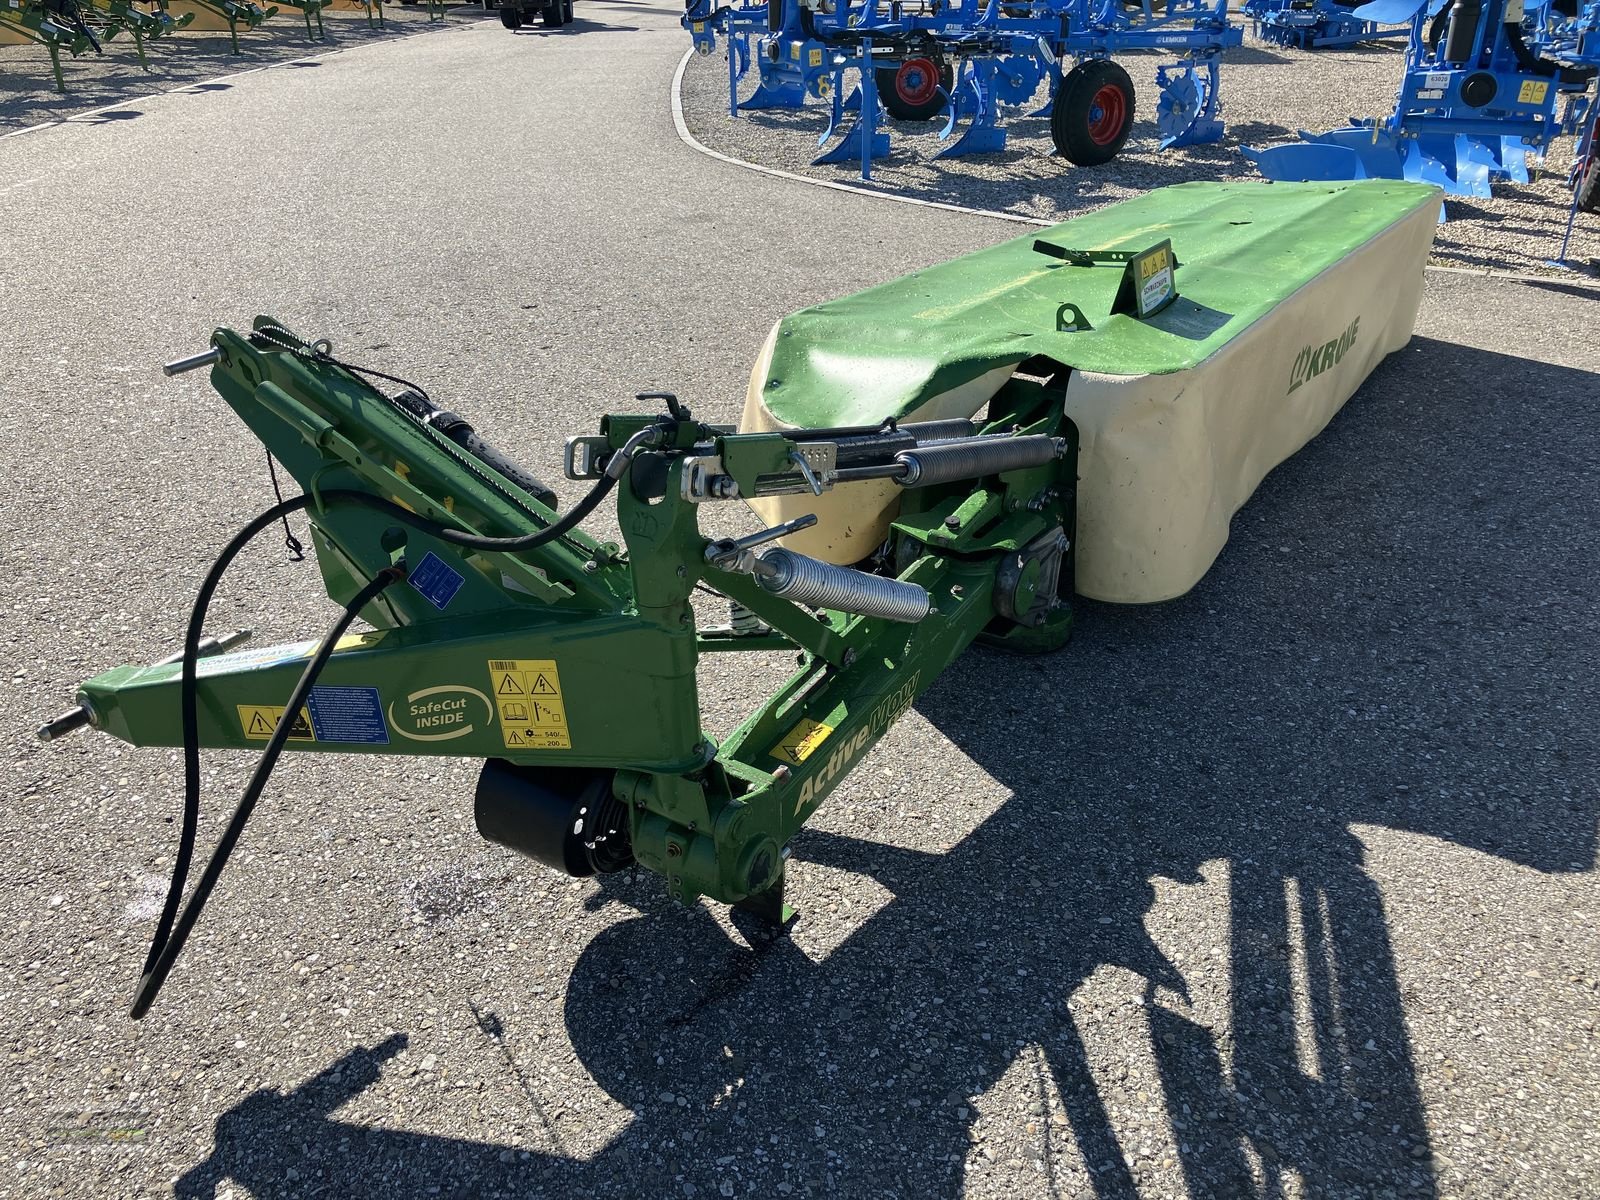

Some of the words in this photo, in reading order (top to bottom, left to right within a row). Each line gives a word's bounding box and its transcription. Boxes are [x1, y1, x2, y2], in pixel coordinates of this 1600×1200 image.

[1305, 315, 1361, 383] KRONE
[410, 698, 467, 716] SafeCut
[416, 712, 464, 729] INSIDE
